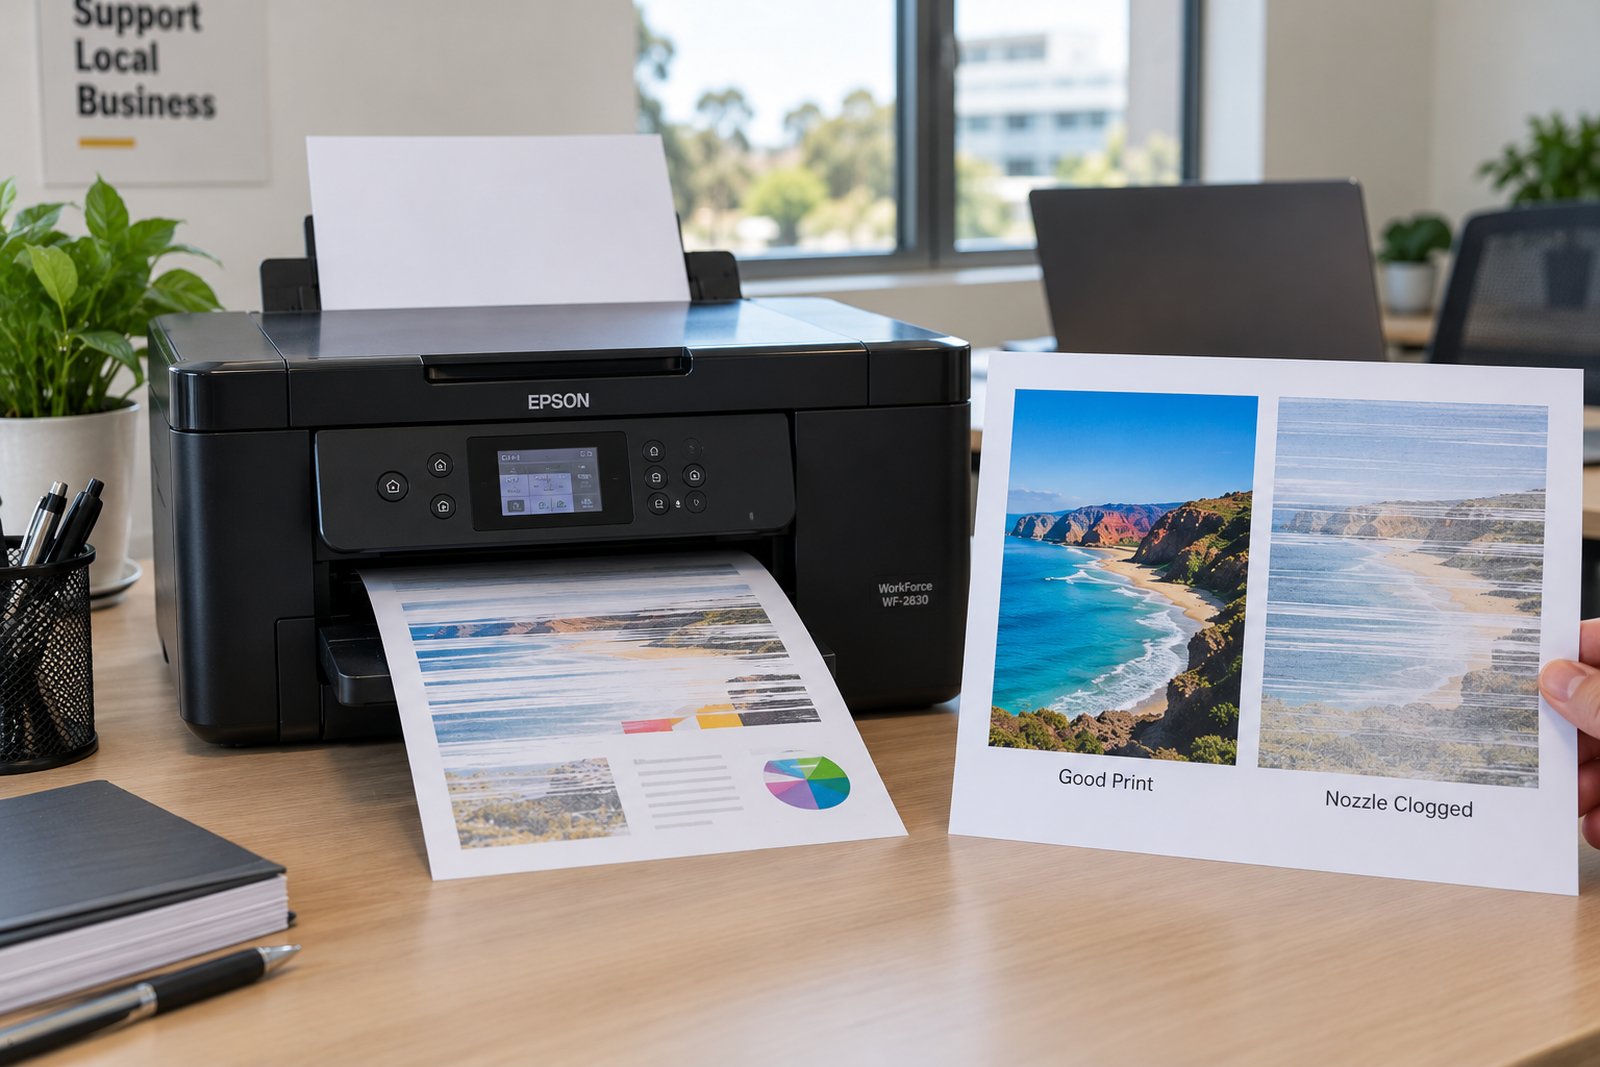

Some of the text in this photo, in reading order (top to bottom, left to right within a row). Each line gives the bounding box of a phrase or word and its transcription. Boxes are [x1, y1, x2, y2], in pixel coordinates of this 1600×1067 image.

[74, 0, 203, 37] Support
[75, 38, 159, 75] Local
[77, 83, 217, 119] Business
[528, 393, 590, 410] EPSON
[878, 582, 933, 594] WorkForce
[882, 595, 929, 607] WF-2830
[1058, 768, 1154, 792] Good Print
[1325, 790, 1474, 820] Nozzle Clogged
